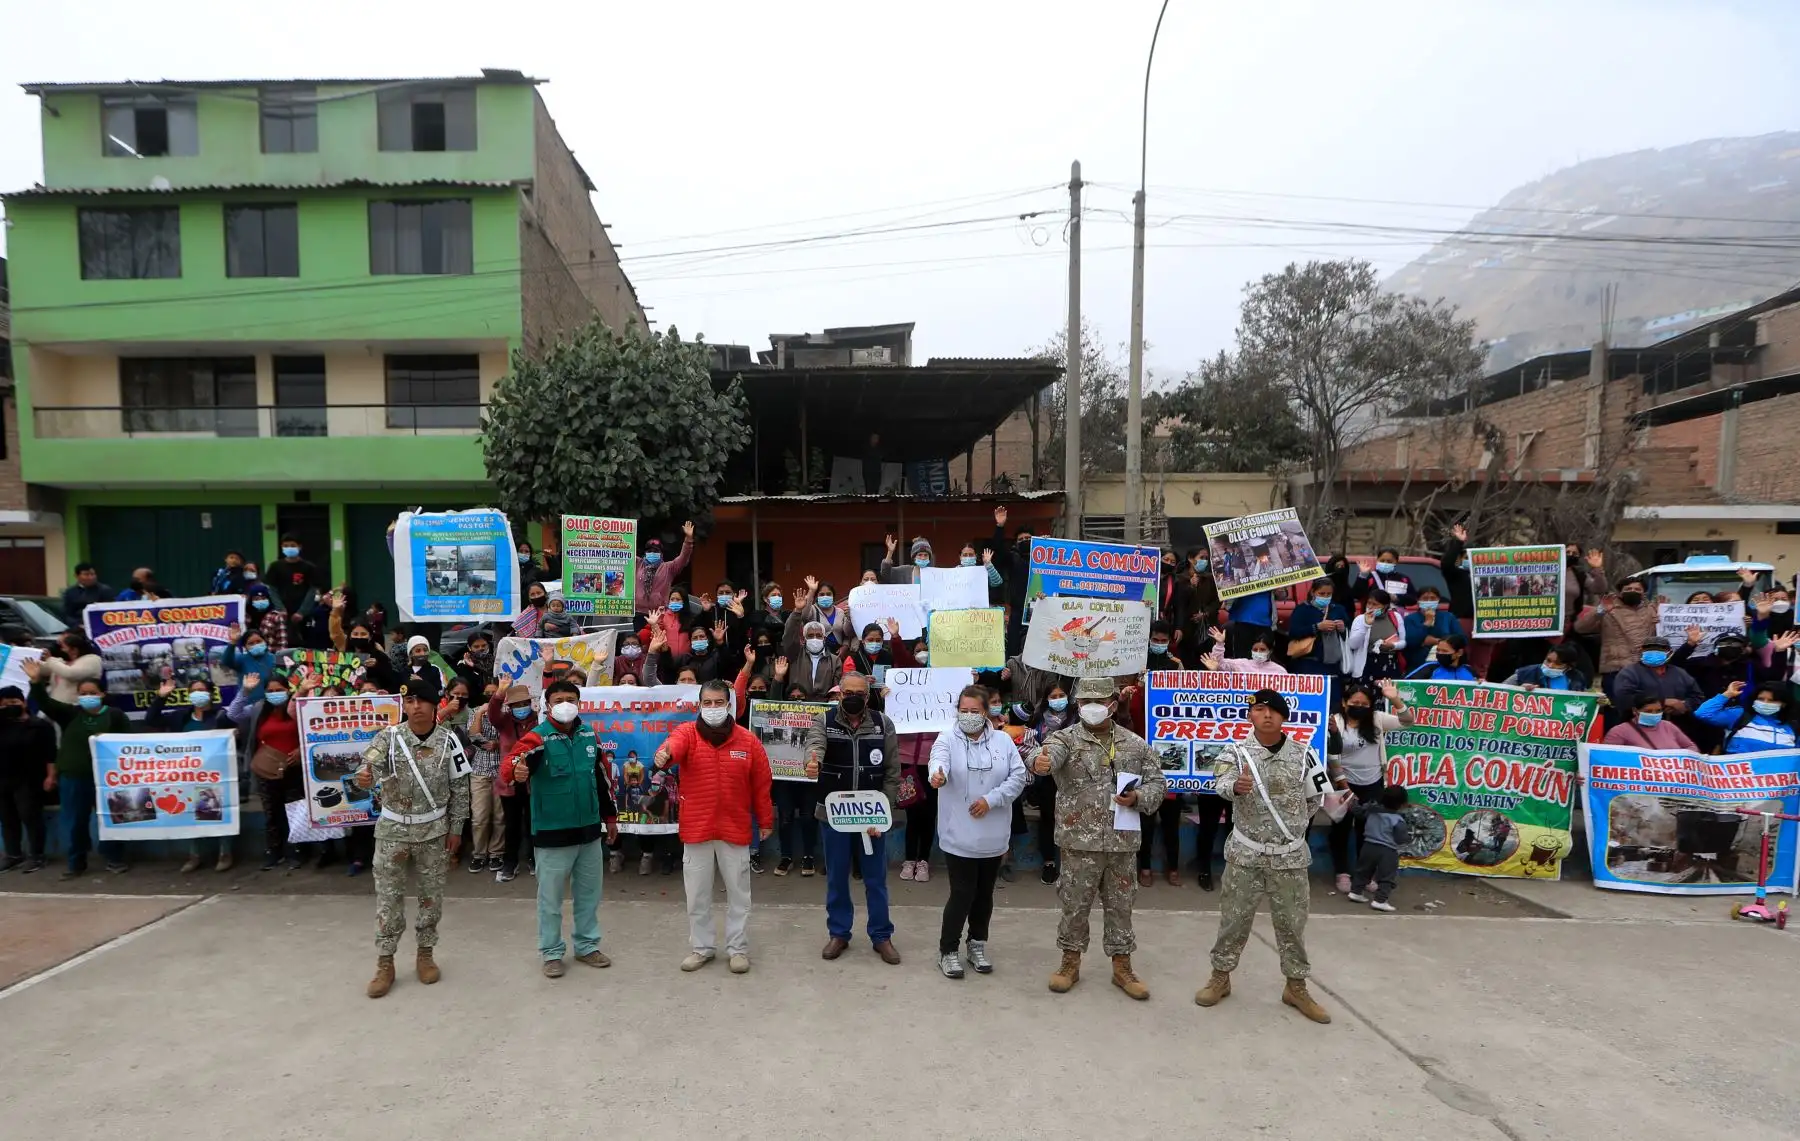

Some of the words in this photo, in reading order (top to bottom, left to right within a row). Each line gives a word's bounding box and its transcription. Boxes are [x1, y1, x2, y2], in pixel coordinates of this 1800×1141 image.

[1228, 532, 1249, 544] OLLA
[612, 551, 632, 559] APOYO
[1031, 546, 1083, 568] OLLA
[1087, 550, 1158, 574] COMÚN
[102, 610, 156, 625] OLLA
[158, 605, 226, 622] COMUN
[96, 627, 137, 649] MARIA
[138, 624, 157, 639] DE
[159, 623, 182, 637] LOS
[1151, 671, 1165, 688] AA
[1166, 671, 1179, 688] HH
[1181, 671, 1198, 689] LAS
[1200, 672, 1230, 690] VEGAS
[1232, 672, 1244, 690] DE
[1245, 673, 1297, 693] VALLECITO
[1298, 674, 1324, 694] BAJO
[1173, 693, 1231, 704] (MARGEN
[1513, 693, 1554, 715] SAN
[323, 700, 375, 715] OLLA
[1155, 706, 1218, 719] OLLA
[1468, 711, 1497, 732] DE
[1500, 715, 1586, 741] PORRAS
[121, 745, 151, 755] Olla
[1446, 735, 1474, 751] LOS
[1478, 739, 1578, 760] FORESTALES
[118, 756, 202, 771] Uniendo
[1727, 762, 1752, 776] DE
[105, 770, 221, 786] Corazones
[1386, 754, 1457, 791] OLLA
[1465, 757, 1573, 807] COMÚN
[1592, 766, 1699, 785] EMERGENCIA
[1178, 780, 1199, 789] 800
[1592, 781, 1626, 791] OLLAS
[1629, 782, 1642, 792] DE
[830, 801, 886, 816] MINSA
[834, 816, 853, 824] DIRIS
[854, 816, 871, 824] LIMA
[872, 816, 887, 824] SUR
